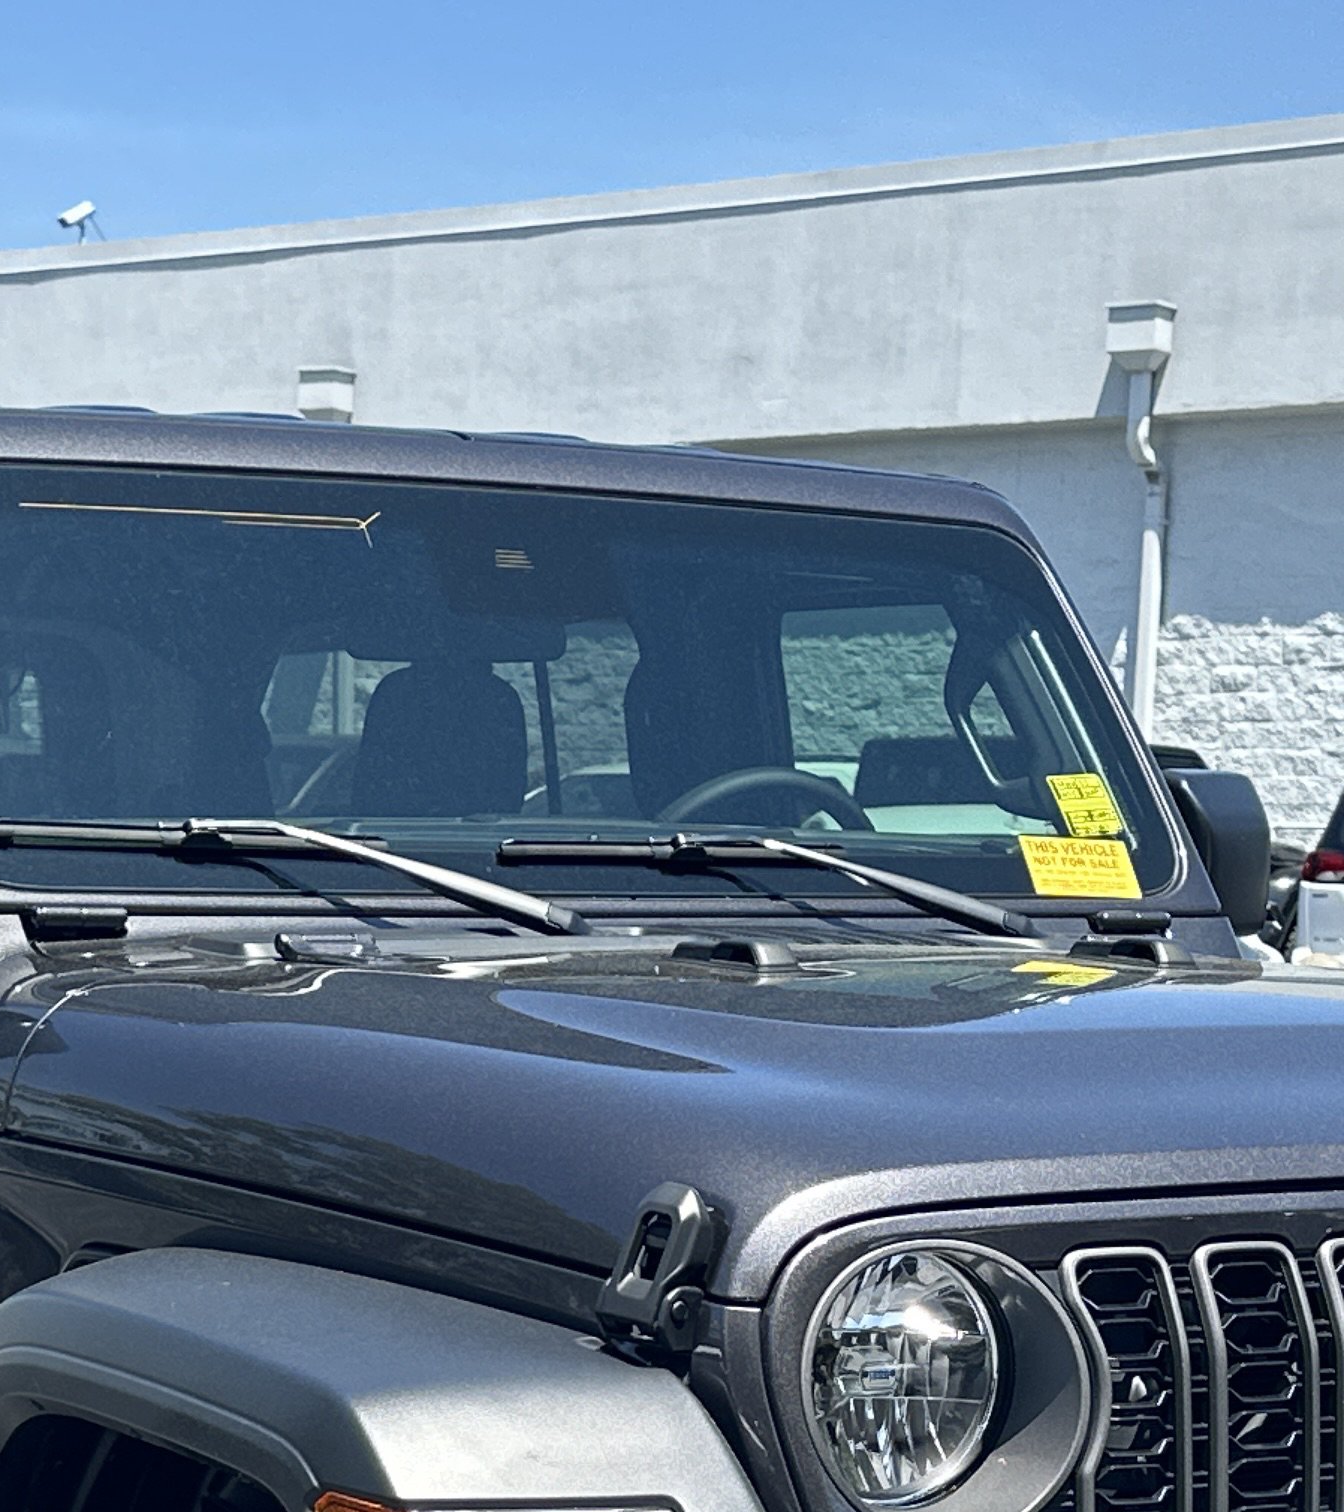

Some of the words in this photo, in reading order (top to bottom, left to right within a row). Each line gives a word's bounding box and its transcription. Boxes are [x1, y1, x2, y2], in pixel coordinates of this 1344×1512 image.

[1025, 840, 1059, 854] THIS
[1061, 842, 1119, 857] VEHICLE
[1032, 856, 1057, 866] NOT
[1061, 857, 1086, 867] FOR
[1089, 859, 1119, 869] SALE
